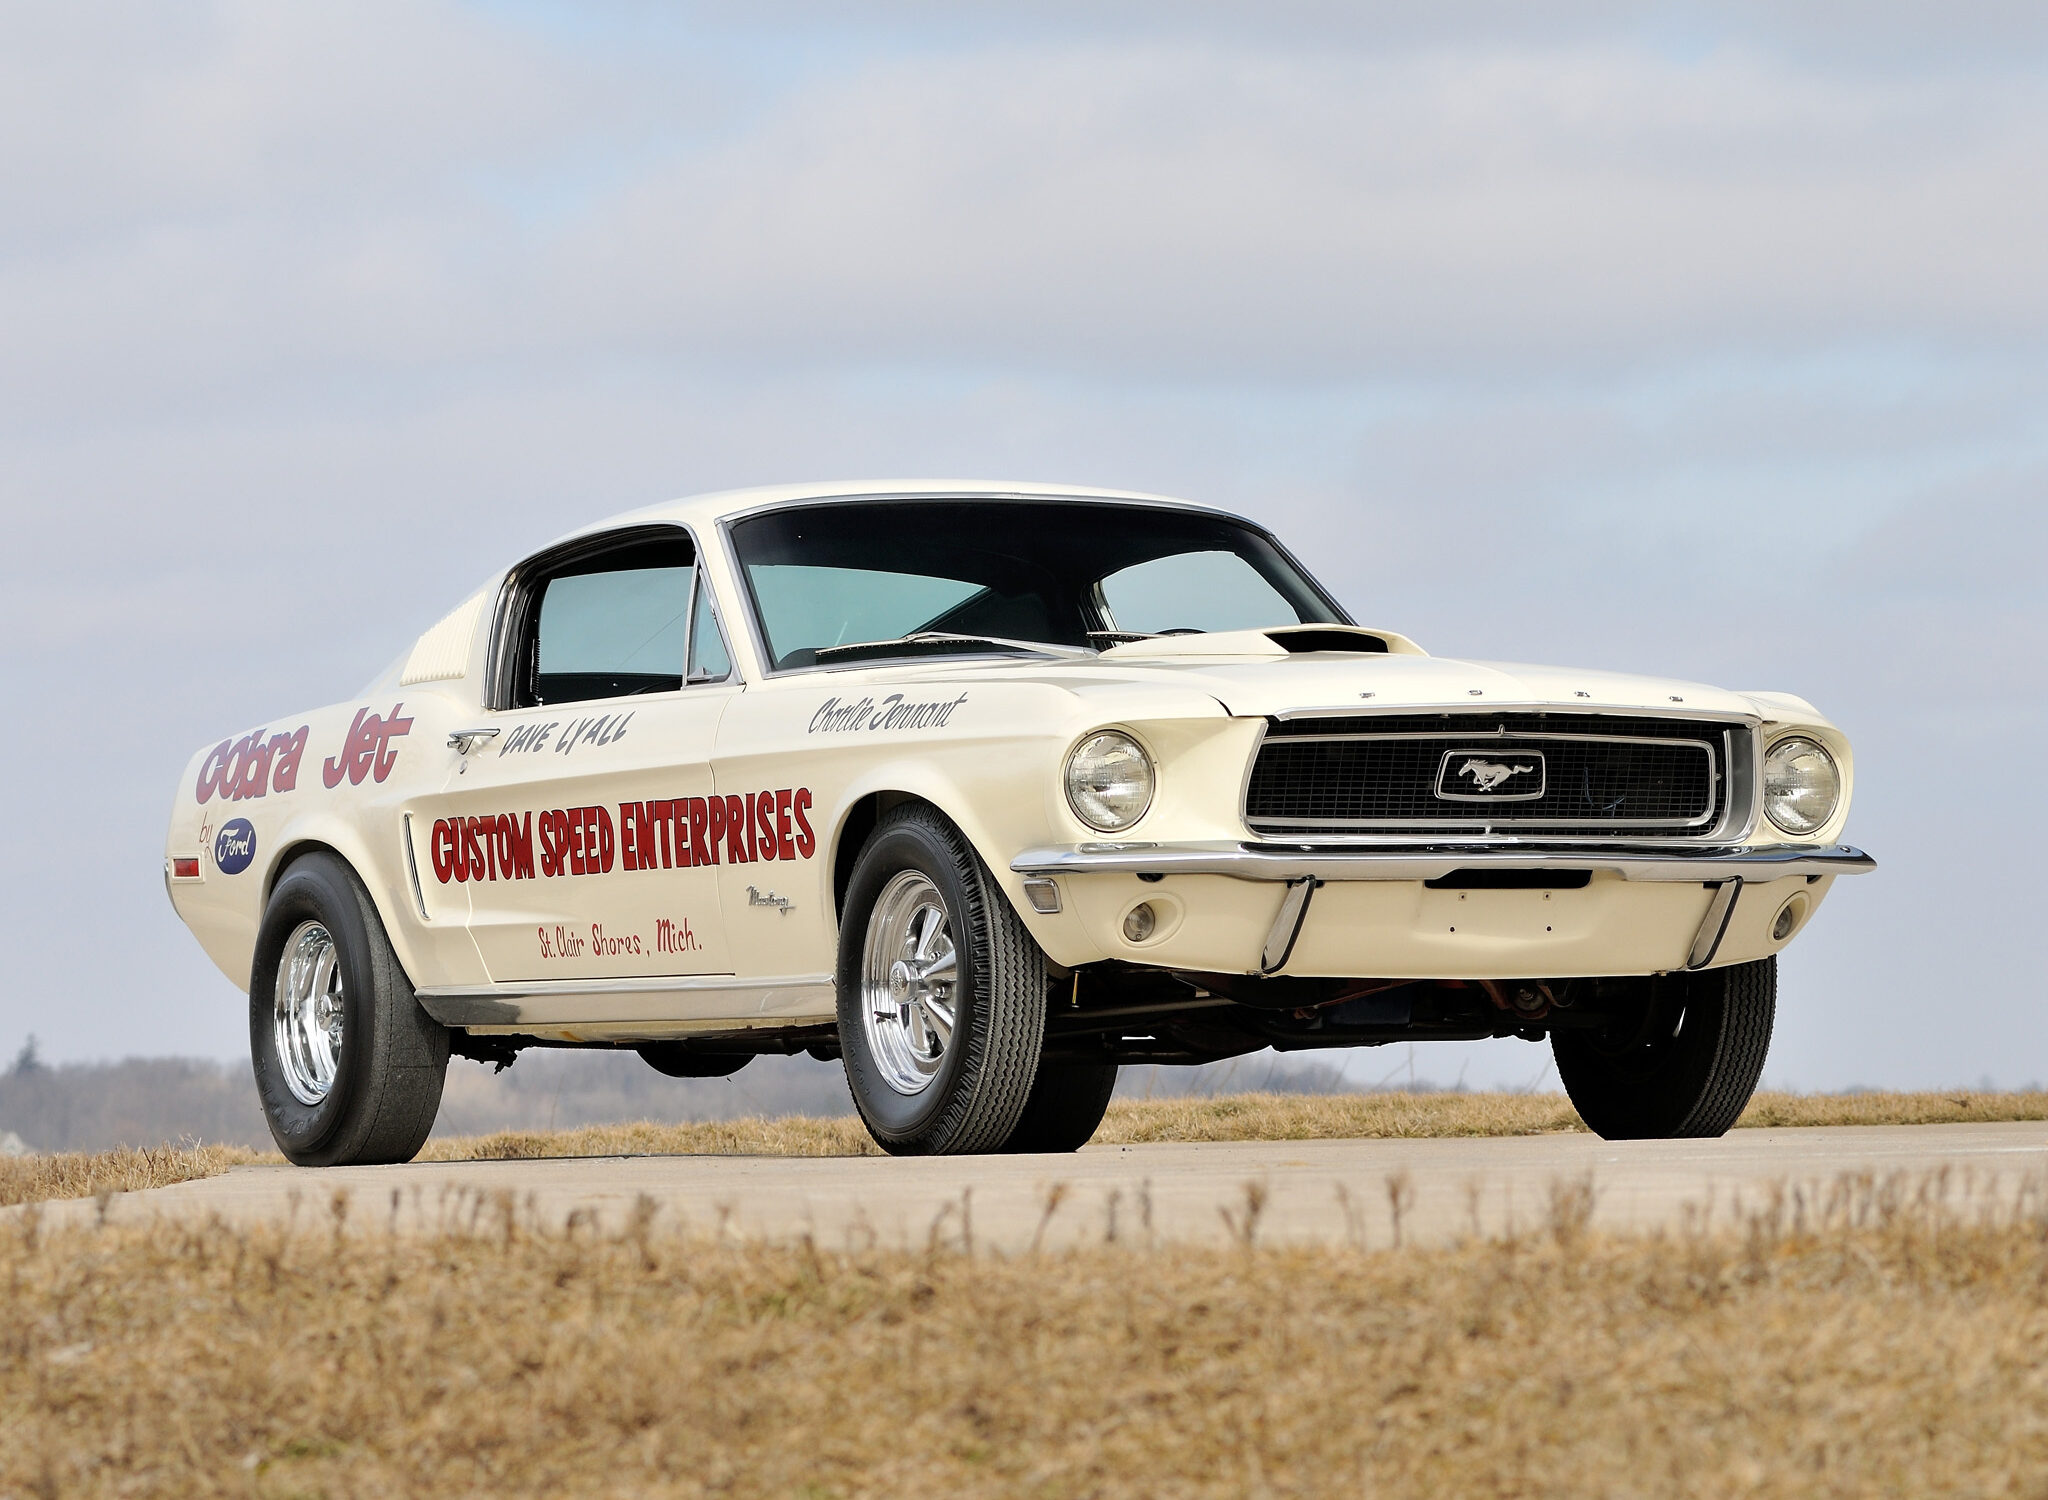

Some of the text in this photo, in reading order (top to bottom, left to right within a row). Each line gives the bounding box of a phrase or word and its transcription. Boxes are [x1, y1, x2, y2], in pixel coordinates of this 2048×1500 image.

[499, 711, 636, 758] DAVE LYALL
[808, 697, 874, 734] Charlie
[195, 703, 414, 804] Cobra Jet
[199, 811, 214, 863] by
[217, 828, 252, 863] Ford
[431, 787, 816, 884] CUSTOM SPEED ENTERPRISES
[556, 925, 584, 957] Clair
[656, 917, 702, 953] Mich.
